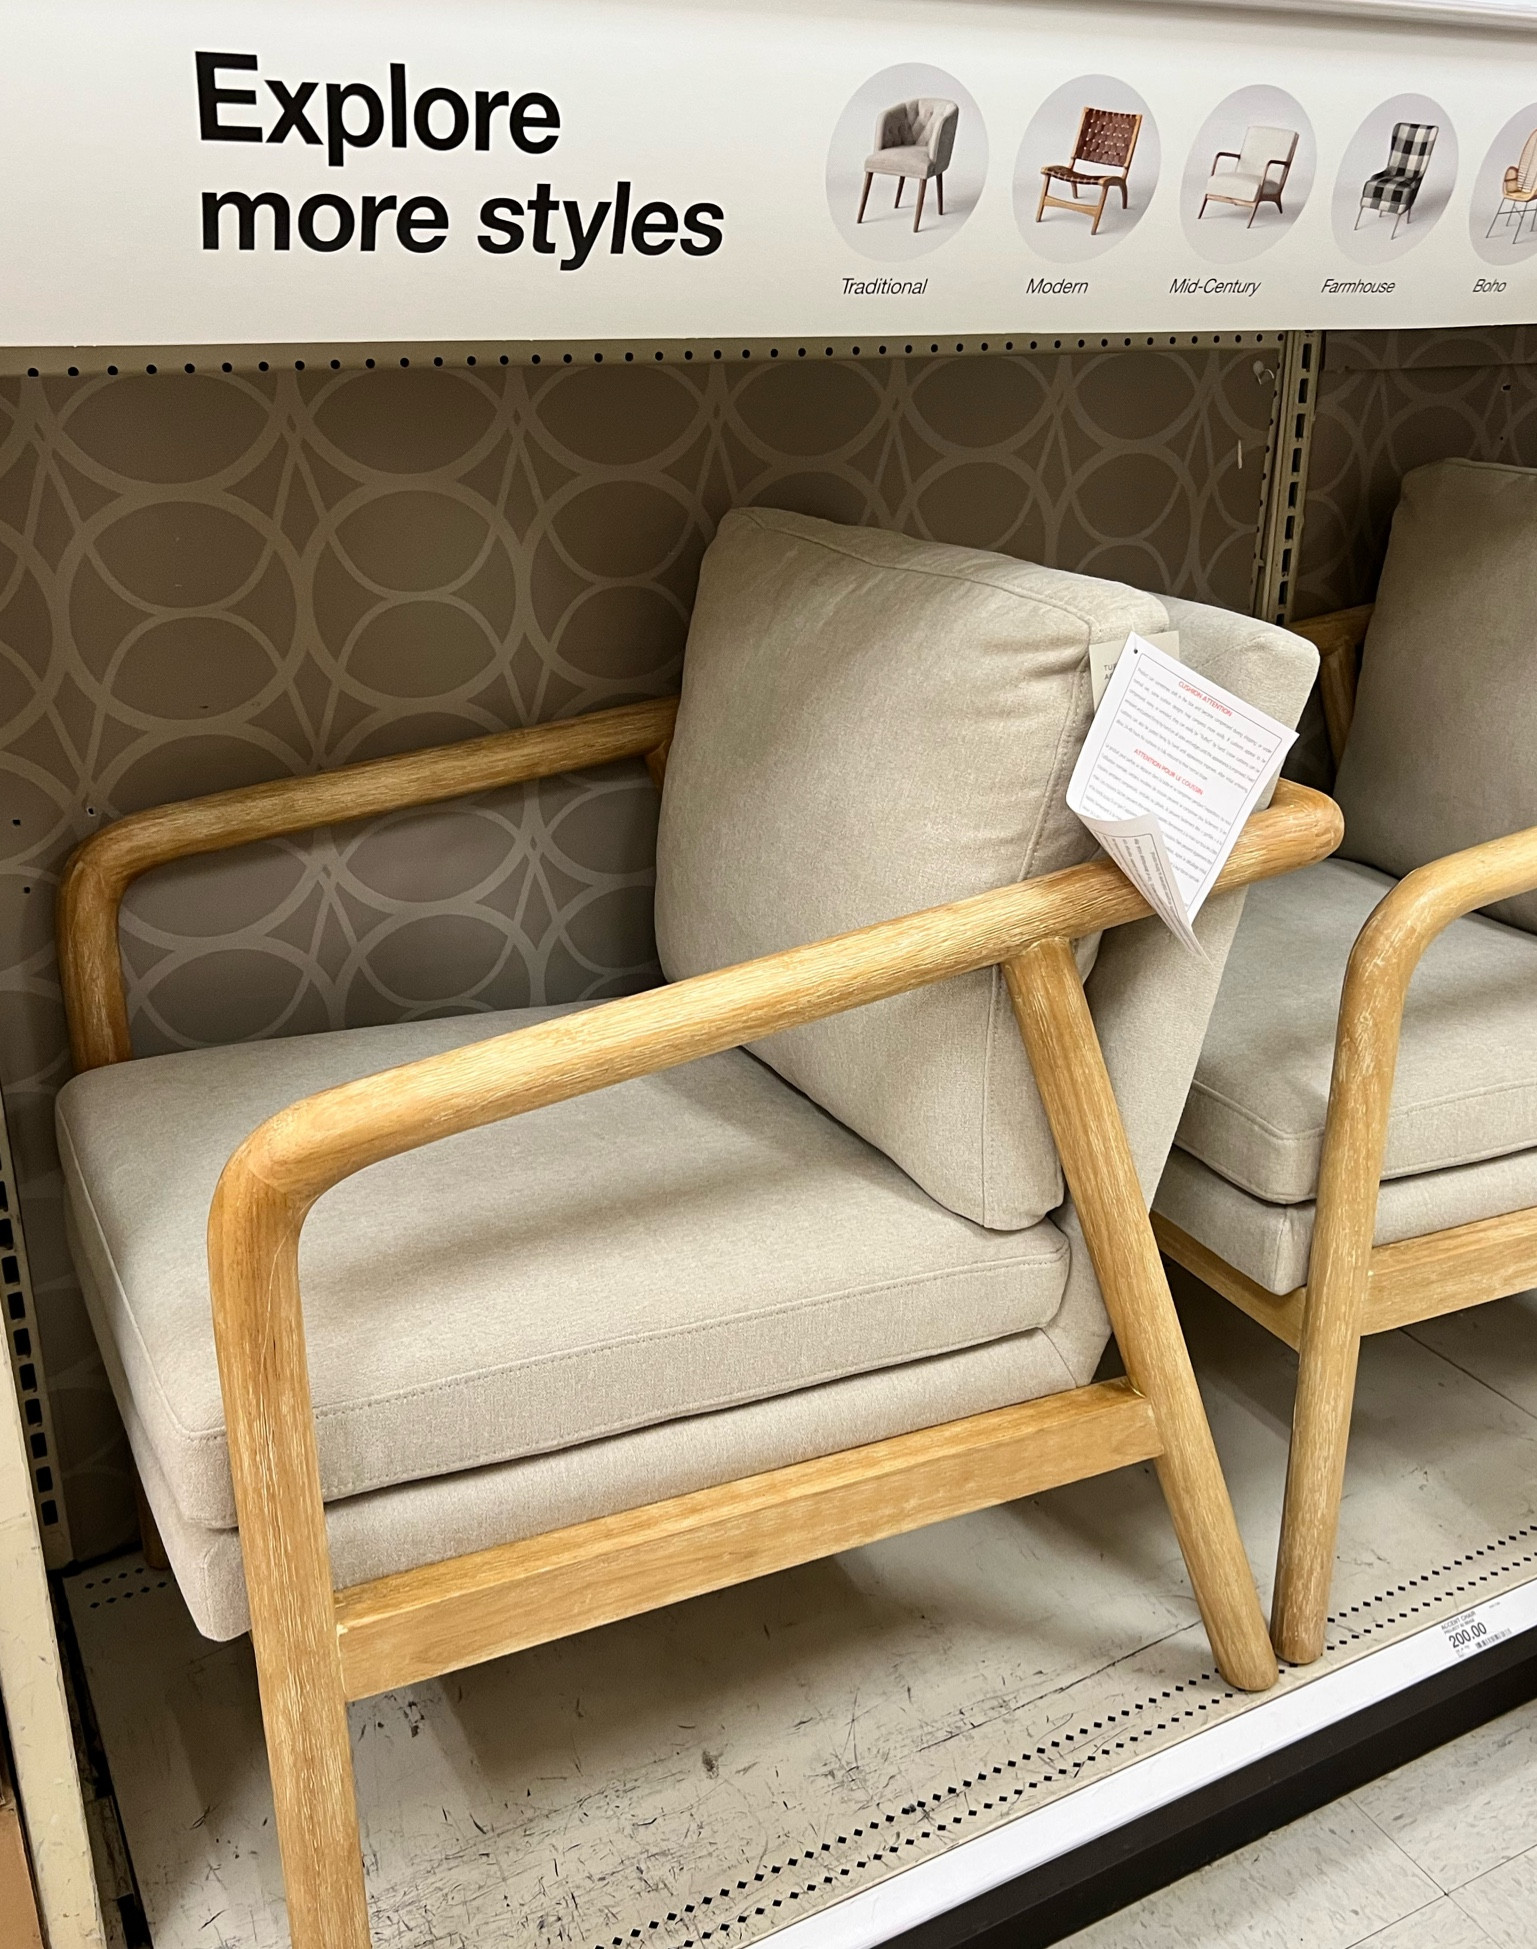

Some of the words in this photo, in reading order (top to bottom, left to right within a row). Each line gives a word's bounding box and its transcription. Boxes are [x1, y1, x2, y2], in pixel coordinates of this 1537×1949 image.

[195, 50, 561, 167] Explore
[201, 191, 449, 254] more
[477, 181, 724, 271] styles
[842, 277, 929, 295] Traditional
[1025, 277, 1089, 295] Modern
[1169, 277, 1262, 298] Mid-Century
[1320, 278, 1396, 294] Farmhouse
[1472, 278, 1507, 293] Boho
[1178, 681, 1203, 699] CUSHION
[1202, 695, 1233, 717] ATTENTION
[1134, 748, 1162, 769] ATTENTION
[1161, 765, 1176, 778] POUR
[1181, 778, 1204, 795] COUSSIN
[1448, 1622, 1487, 1648] 200.00
